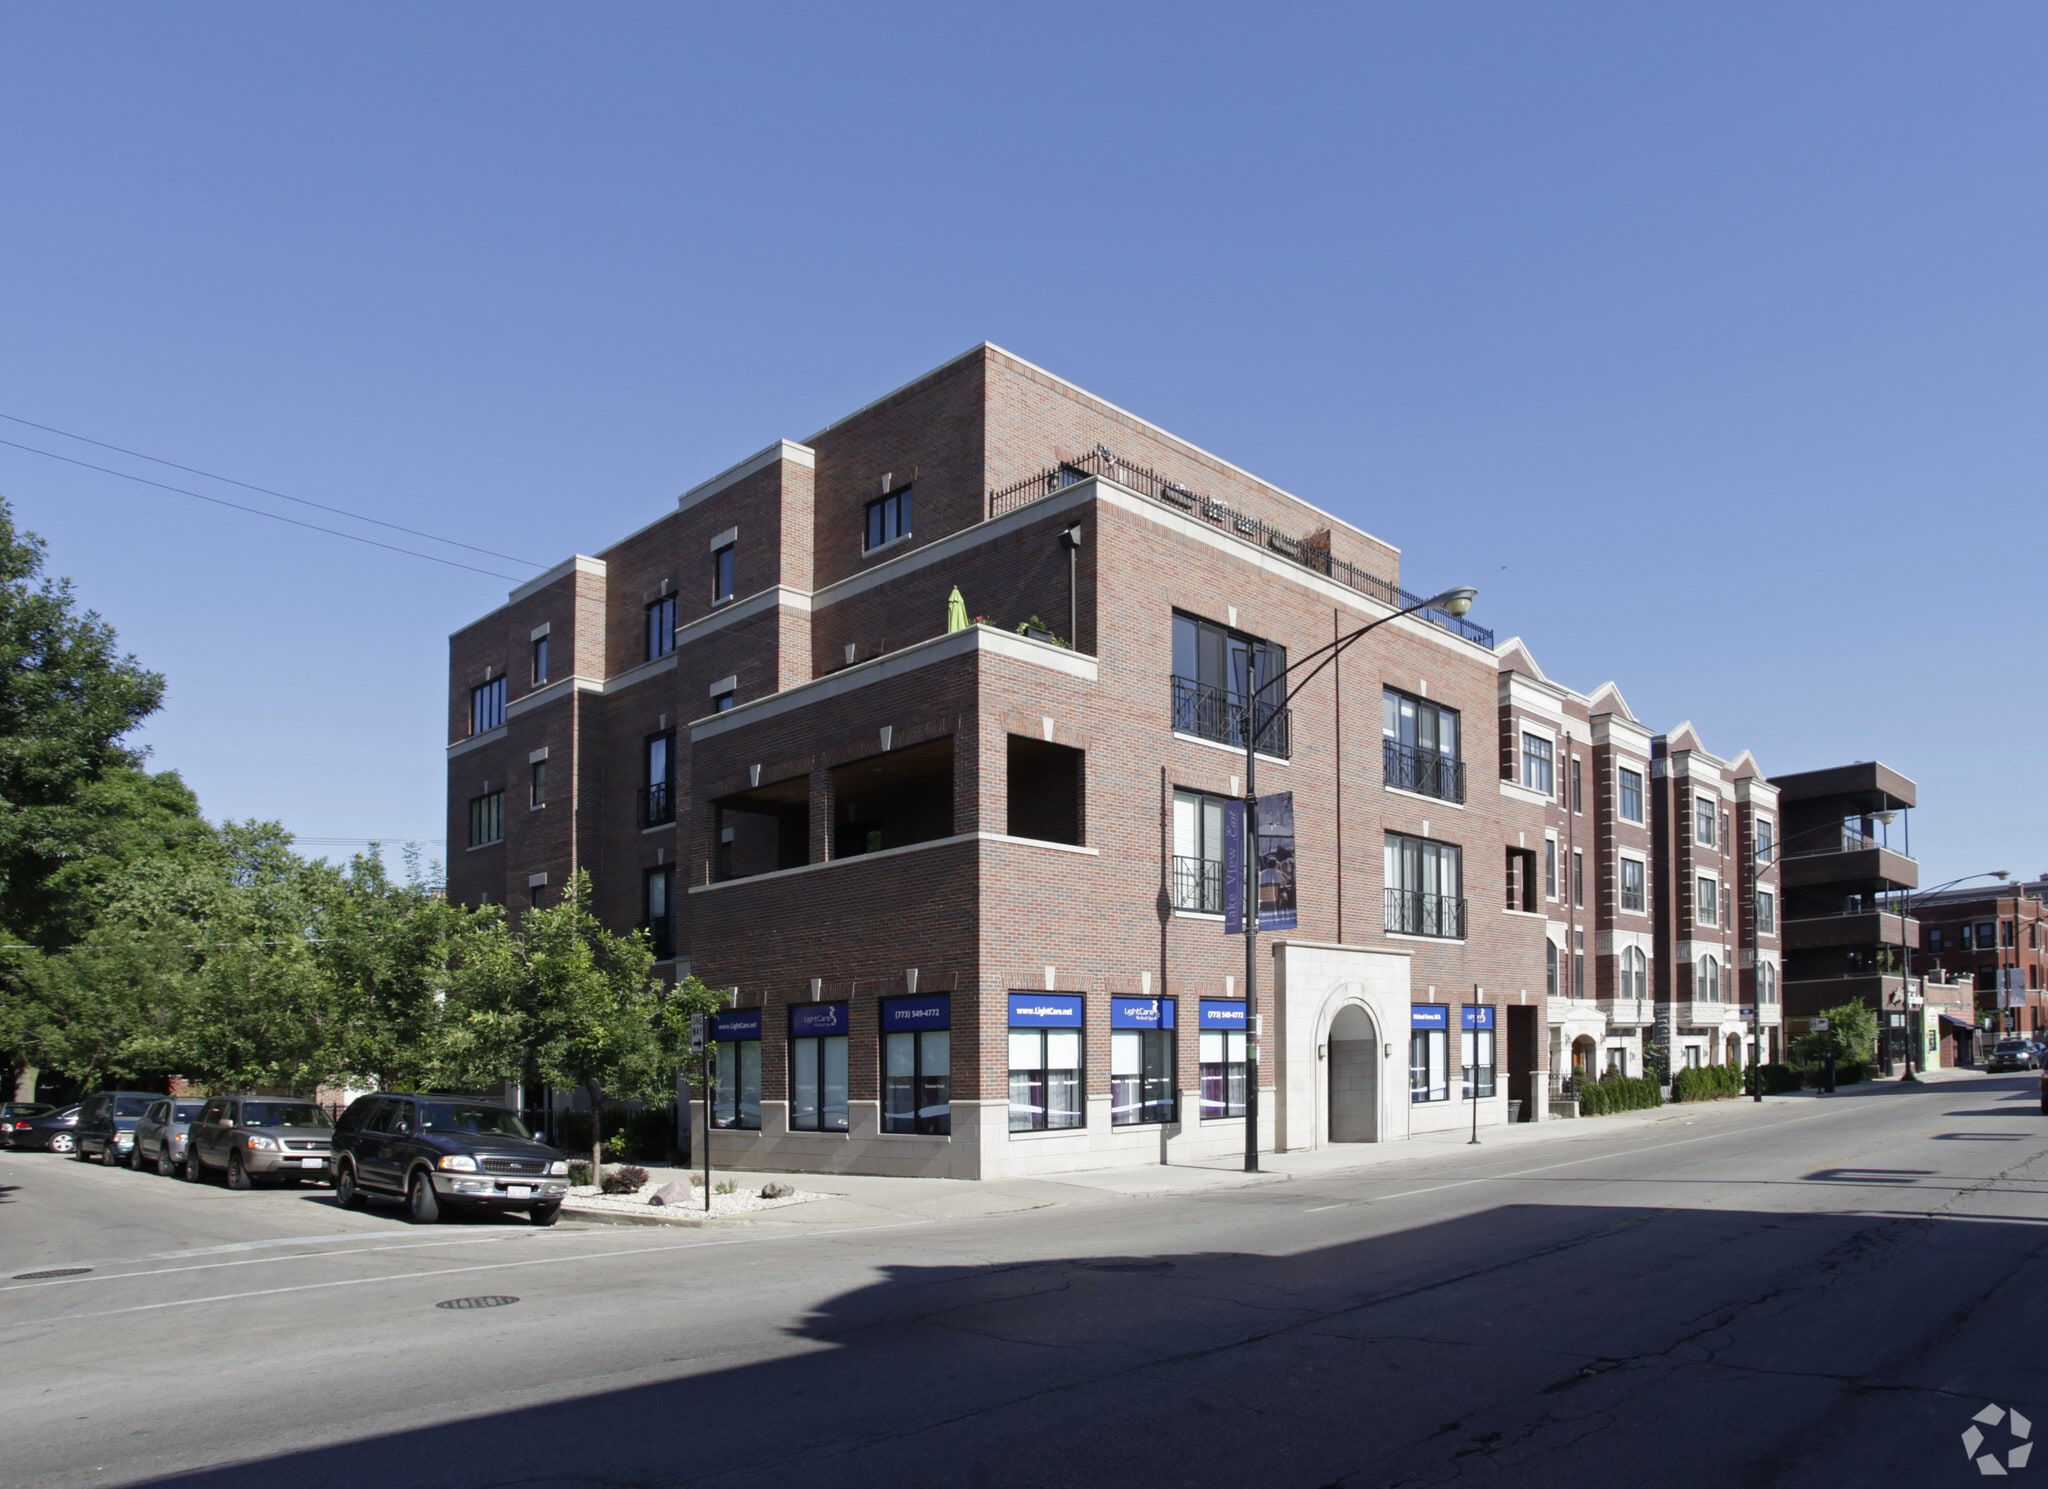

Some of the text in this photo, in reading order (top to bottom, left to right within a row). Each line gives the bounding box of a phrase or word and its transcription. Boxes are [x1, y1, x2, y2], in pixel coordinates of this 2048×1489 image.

[1227, 848, 1237, 884] View
[1227, 894, 1237, 926] Lake
[895, 1009, 940, 1020] (773) 549-4772
[1016, 1007, 1073, 1017] www.LightCare.net
[1124, 1007, 1154, 1016] LightCare
[693, 1015, 703, 1025] ONE
[719, 1022, 757, 1031] www.LightCare.net
[693, 1027, 703, 1037] WAY
